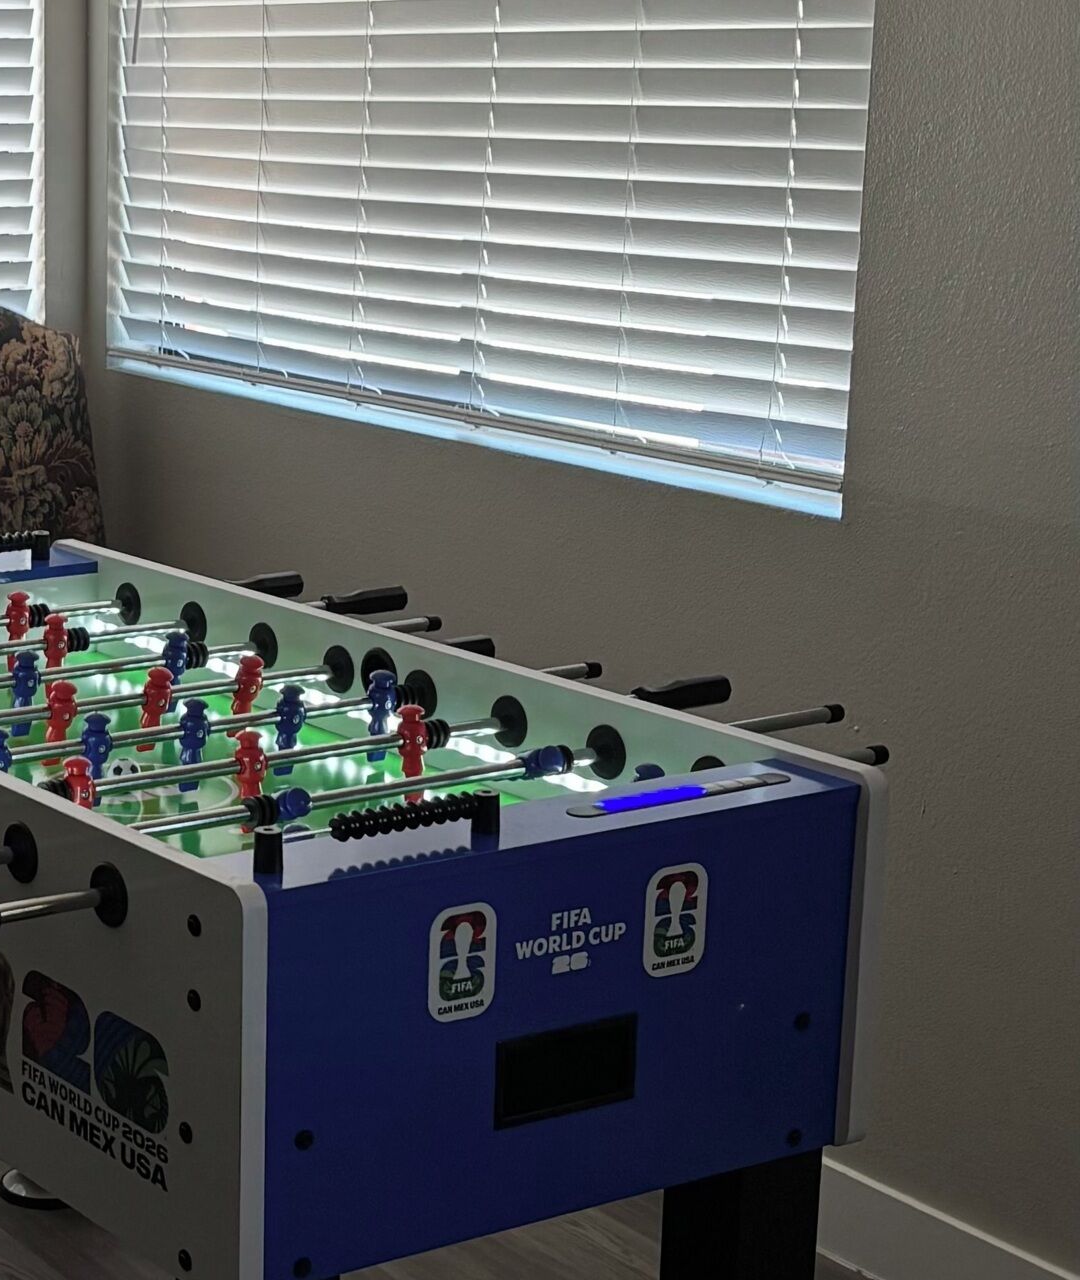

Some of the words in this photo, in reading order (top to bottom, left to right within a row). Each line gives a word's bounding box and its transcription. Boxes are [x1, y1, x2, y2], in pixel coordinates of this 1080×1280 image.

[551, 907, 592, 932] FIFA
[515, 930, 586, 960] WORLD
[588, 922, 627, 945] CUP
[664, 938, 684, 950] FIFA
[551, 951, 589, 975] 26
[652, 962, 666, 971] CAN
[666, 958, 681, 967] MEX
[681, 955, 695, 965] USA
[451, 980, 473, 994] FIFA
[437, 1005, 453, 1015] CAN
[453, 1002, 469, 1012] MEX
[469, 999, 484, 1009] USA
[22, 970, 169, 1134] 26
[22, 1060, 46, 1089] FIFA
[48, 1076, 92, 1117] WORLD
[94, 1105, 119, 1131] CUP
[122, 1122, 169, 1164] 2026
[22, 1081, 65, 1127] CAN
[69, 1111, 116, 1160] MEX
[121, 1142, 168, 1192] USA
